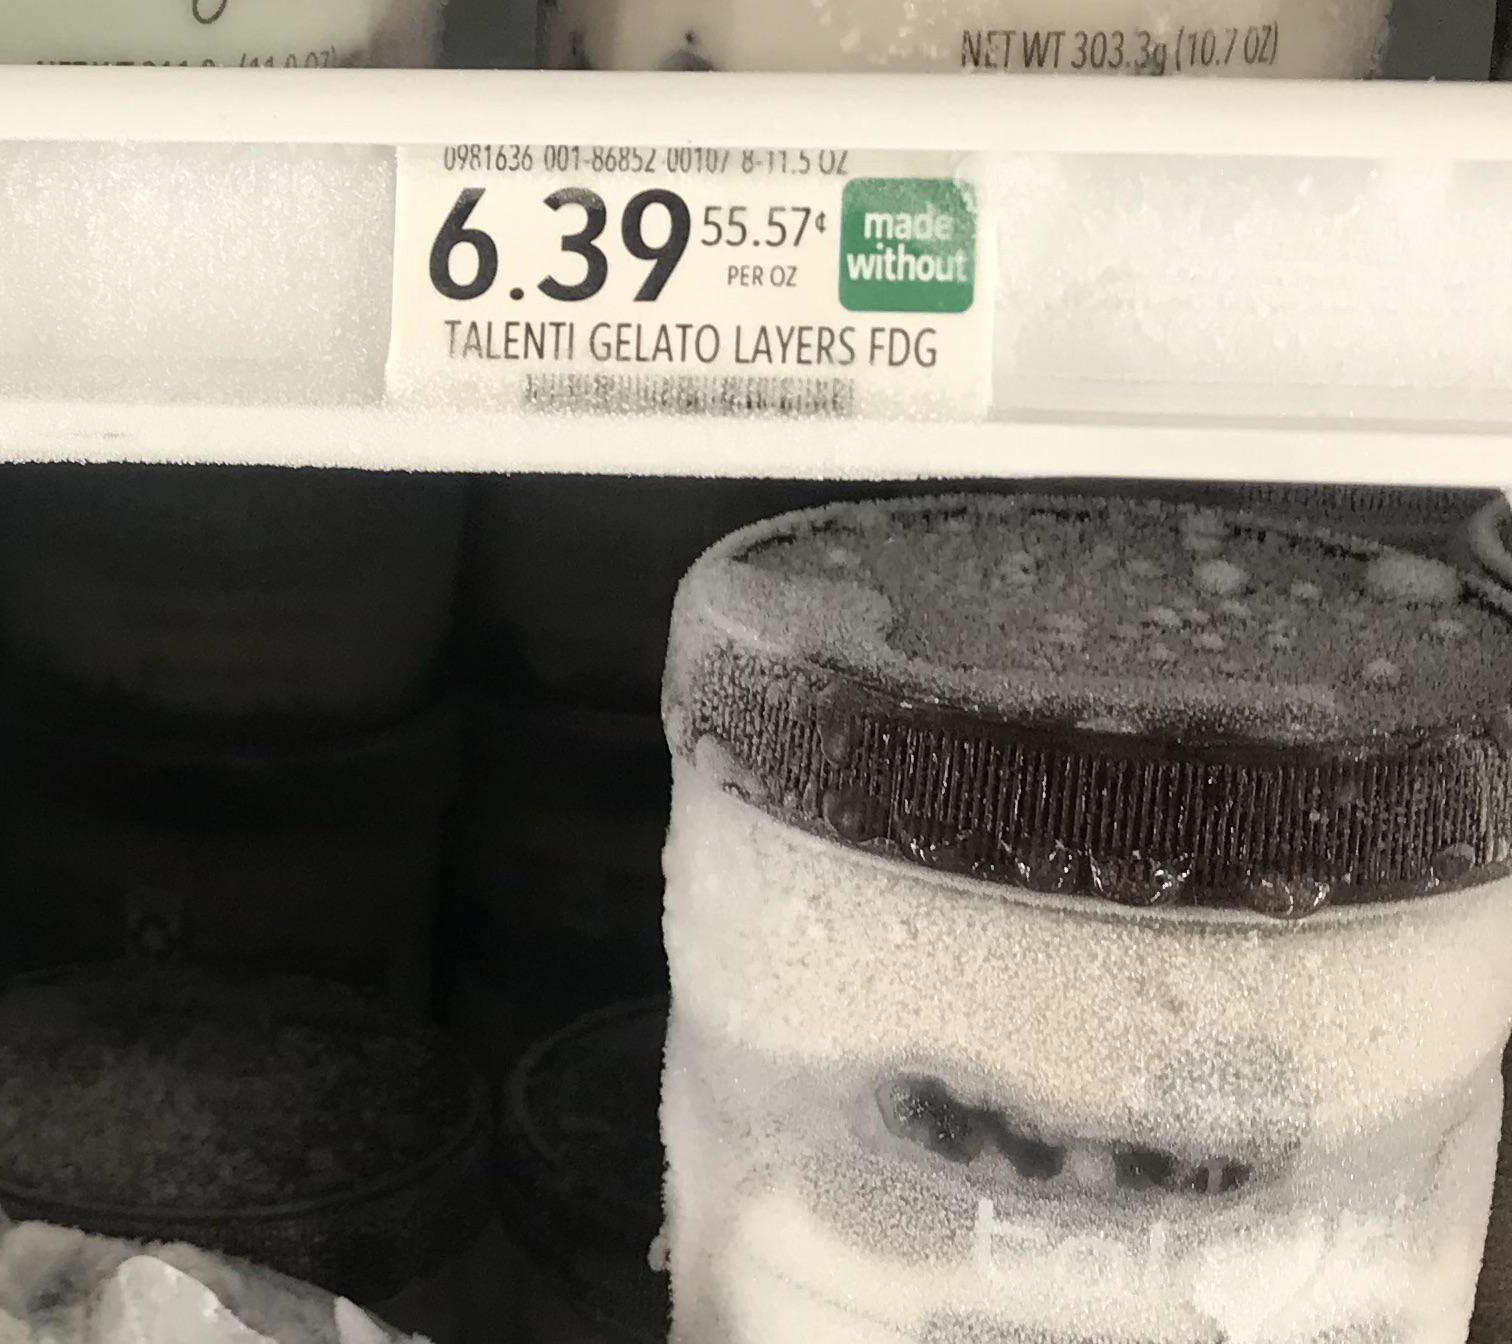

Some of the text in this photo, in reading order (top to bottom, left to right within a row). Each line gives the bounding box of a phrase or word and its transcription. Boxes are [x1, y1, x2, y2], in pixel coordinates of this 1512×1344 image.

[962, 29, 1016, 69] NET
[1023, 29, 1066, 69] WT
[1071, 29, 1168, 76] 303.3g
[864, 203, 954, 241] made
[429, 186, 692, 302] 6.39
[846, 244, 969, 283] without
[727, 266, 798, 288] PER OZ
[444, 320, 938, 367] TALENTI GELATO LAYERS FDG
